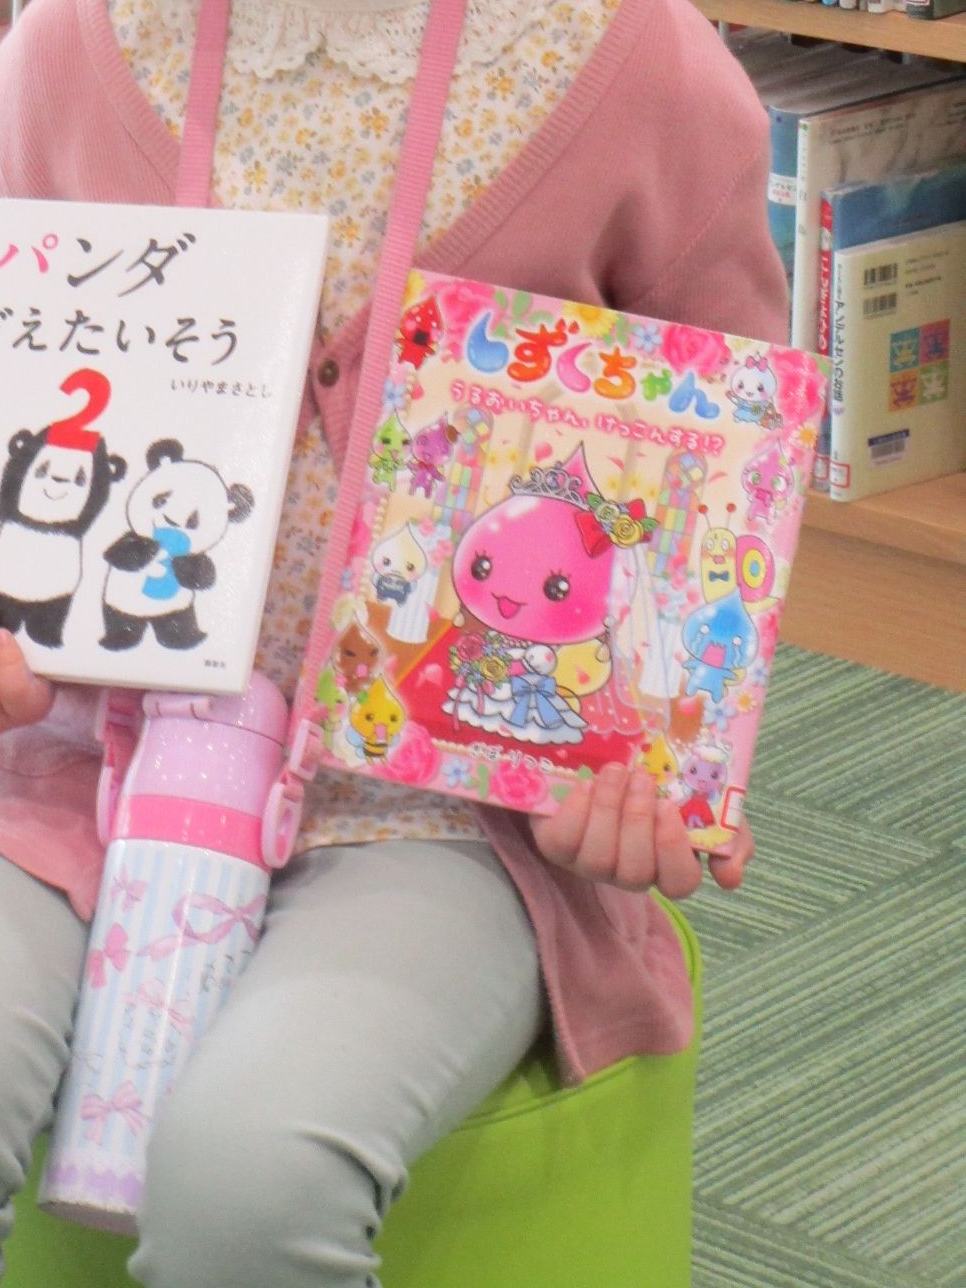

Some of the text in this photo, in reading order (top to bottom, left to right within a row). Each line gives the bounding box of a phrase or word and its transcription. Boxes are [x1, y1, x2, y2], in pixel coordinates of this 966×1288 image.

[170, 377, 273, 399] いりやまさとし
[465, 310, 721, 420] しずくちゃん
[46, 367, 112, 453] 2
[450, 379, 725, 458] うるおいちゃん、 けっこんする!?
